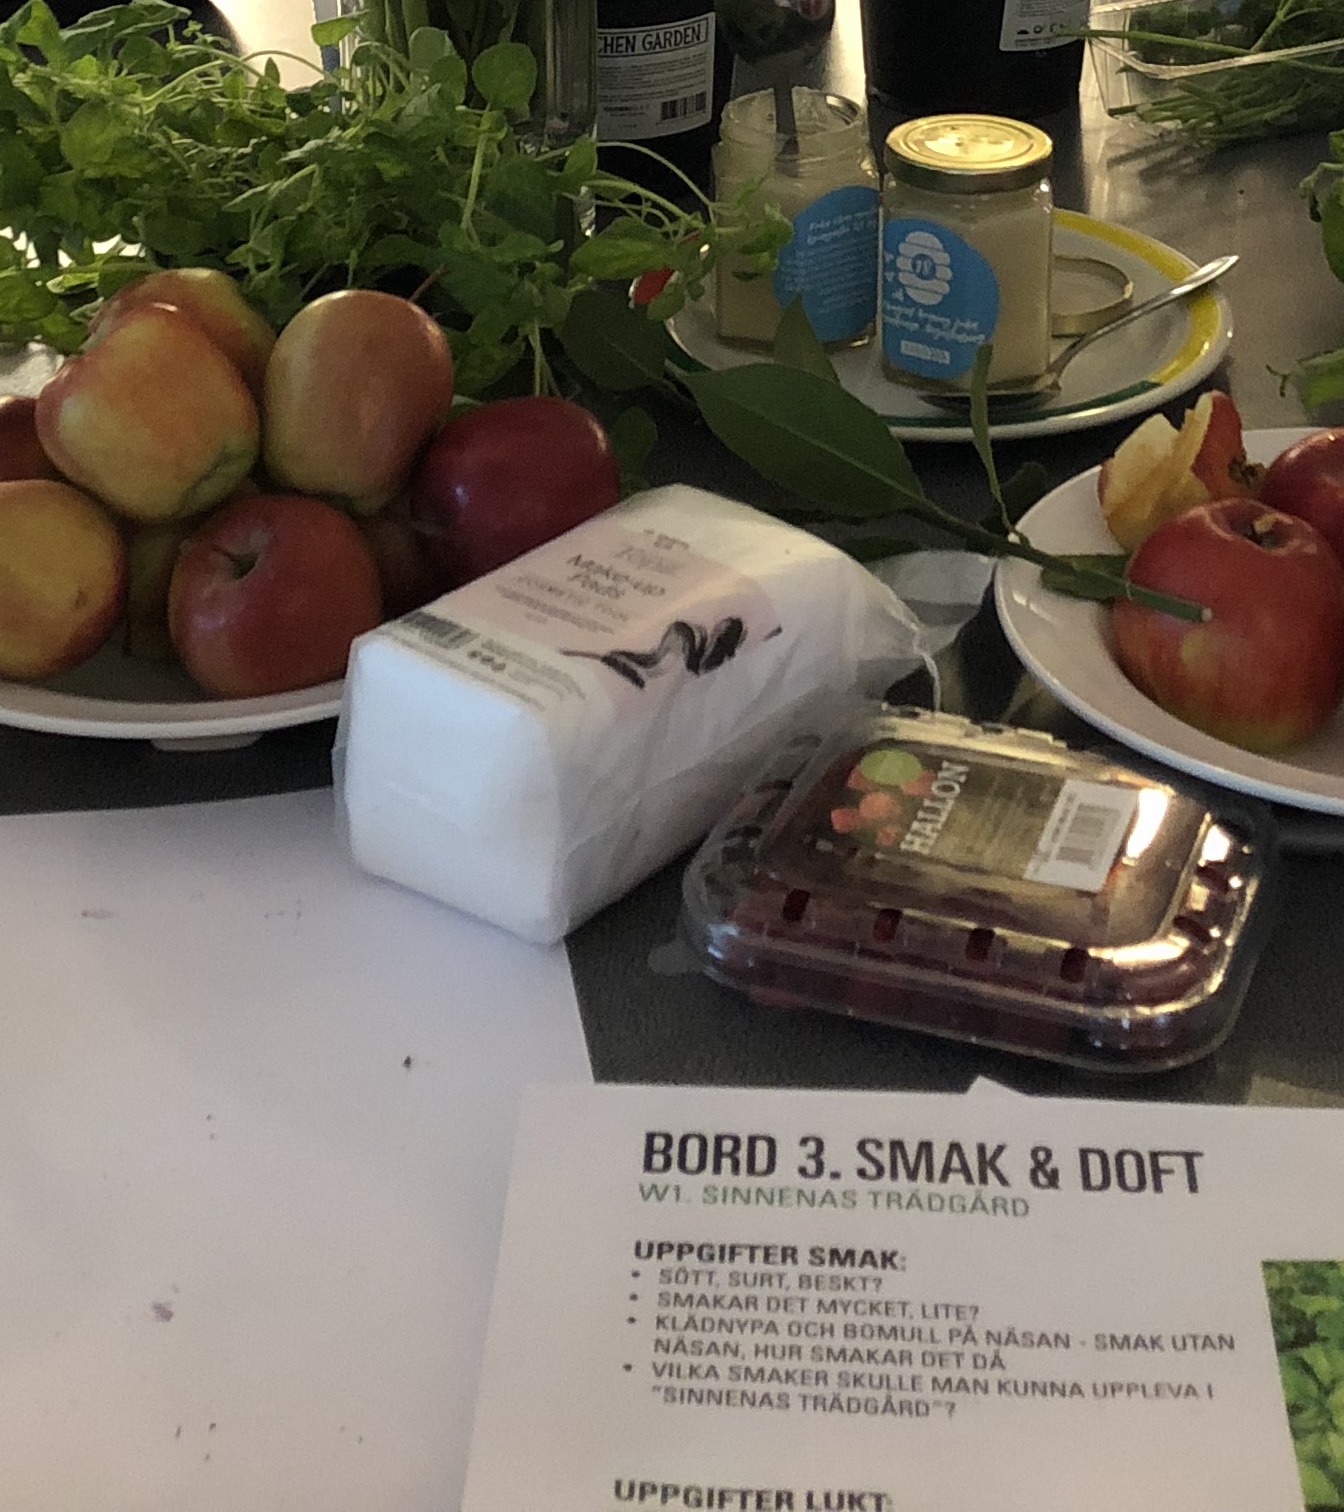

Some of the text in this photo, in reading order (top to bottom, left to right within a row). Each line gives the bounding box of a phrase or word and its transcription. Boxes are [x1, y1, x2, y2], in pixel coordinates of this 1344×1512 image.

[641, 23, 701, 51] GARDEN
[899, 760, 969, 855] HALLON
[643, 1130, 1205, 1194] BORD 3. SMAK & DOFT
[702, 1185, 859, 1210] SINNENAS
[868, 1188, 1030, 1218] TRÄDGÅRD
[634, 1240, 907, 1271] UPPGIFTER SMAK:
[658, 1265, 884, 1294] SÖTT, SURT, BESKT?
[657, 1291, 980, 1322] SMAKAR DET MYCKET, LITE?
[655, 1313, 780, 1337] KLÄDNYPA
[787, 1320, 836, 1340] OCH
[843, 1322, 940, 1345] BOMULL
[947, 1325, 979, 1347] PÅ
[985, 1327, 1072, 1350] NÄSAN
[1094, 1332, 1166, 1353] SMAK
[1171, 1333, 1236, 1352] UTAN
[653, 1337, 1006, 1371] NÄSAN, HUR SMAKAR DET DÅ
[652, 1360, 1214, 1401] VILKA SMAKER SKULLE MAN KUNNA UPPLEVA I
[613, 1478, 894, 1512] UPPGIFTER LUKT:
